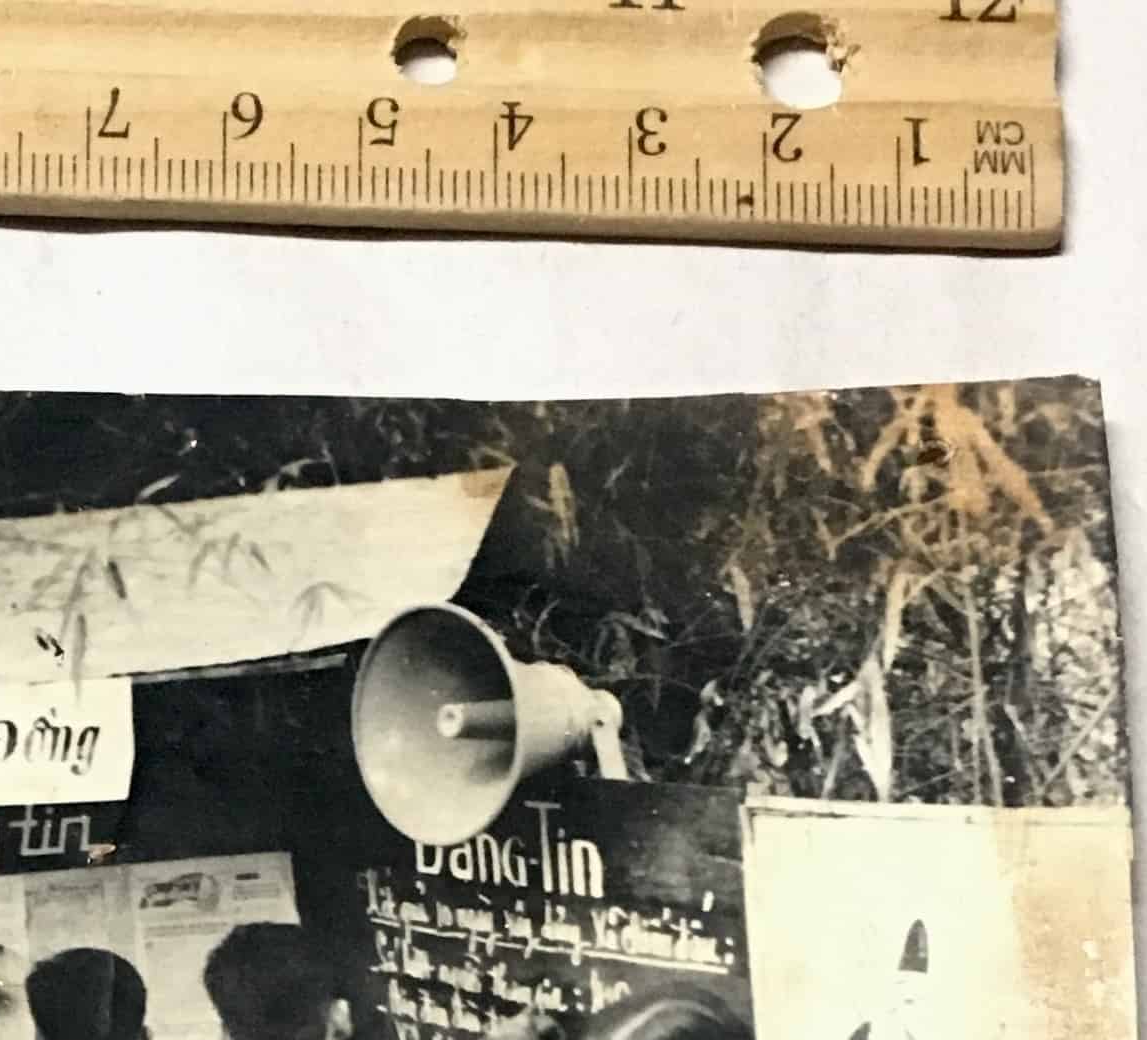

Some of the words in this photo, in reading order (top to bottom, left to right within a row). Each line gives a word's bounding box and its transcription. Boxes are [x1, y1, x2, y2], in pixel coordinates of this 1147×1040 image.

[97, 87, 132, 139] 7
[230, 92, 264, 139] 6
[366, 97, 400, 147] 5
[500, 101, 535, 153] 4
[635, 107, 669, 156] 3
[770, 112, 804, 163] 2
[976, 119, 1025, 146] CM
[904, 117, 931, 166] 1
[973, 149, 1026, 175] MM
[7, 804, 92, 857] tin
